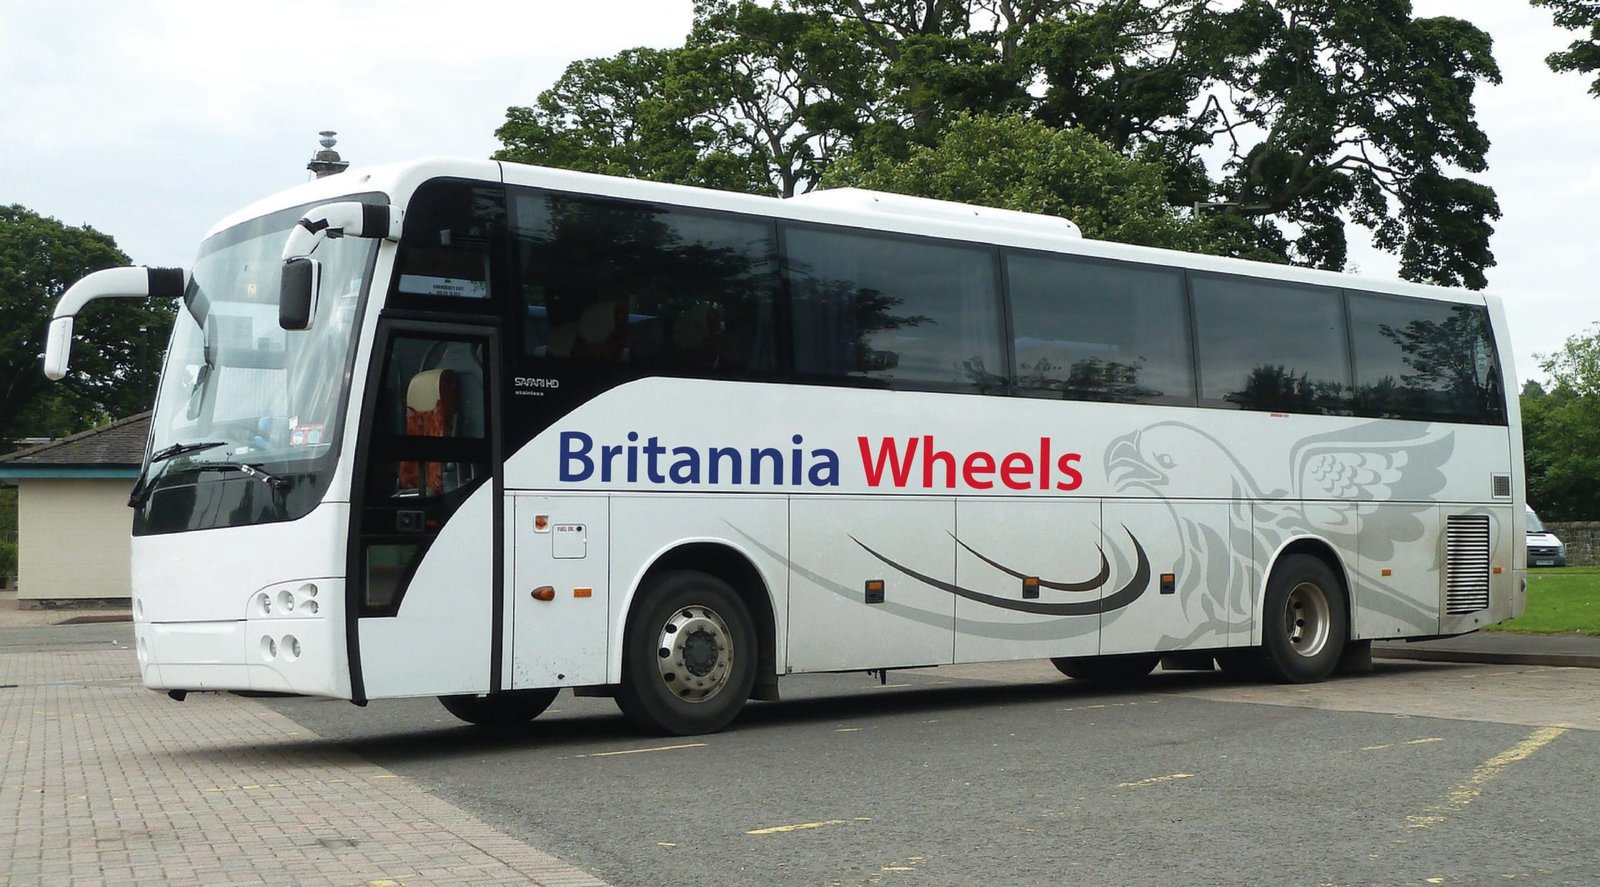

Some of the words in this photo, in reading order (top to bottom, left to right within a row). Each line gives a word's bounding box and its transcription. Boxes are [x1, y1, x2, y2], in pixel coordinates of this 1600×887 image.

[514, 377, 545, 388] SAFARI
[545, 378, 560, 388] HD
[559, 431, 840, 486] Britannia
[858, 435, 1083, 490] Wheels
